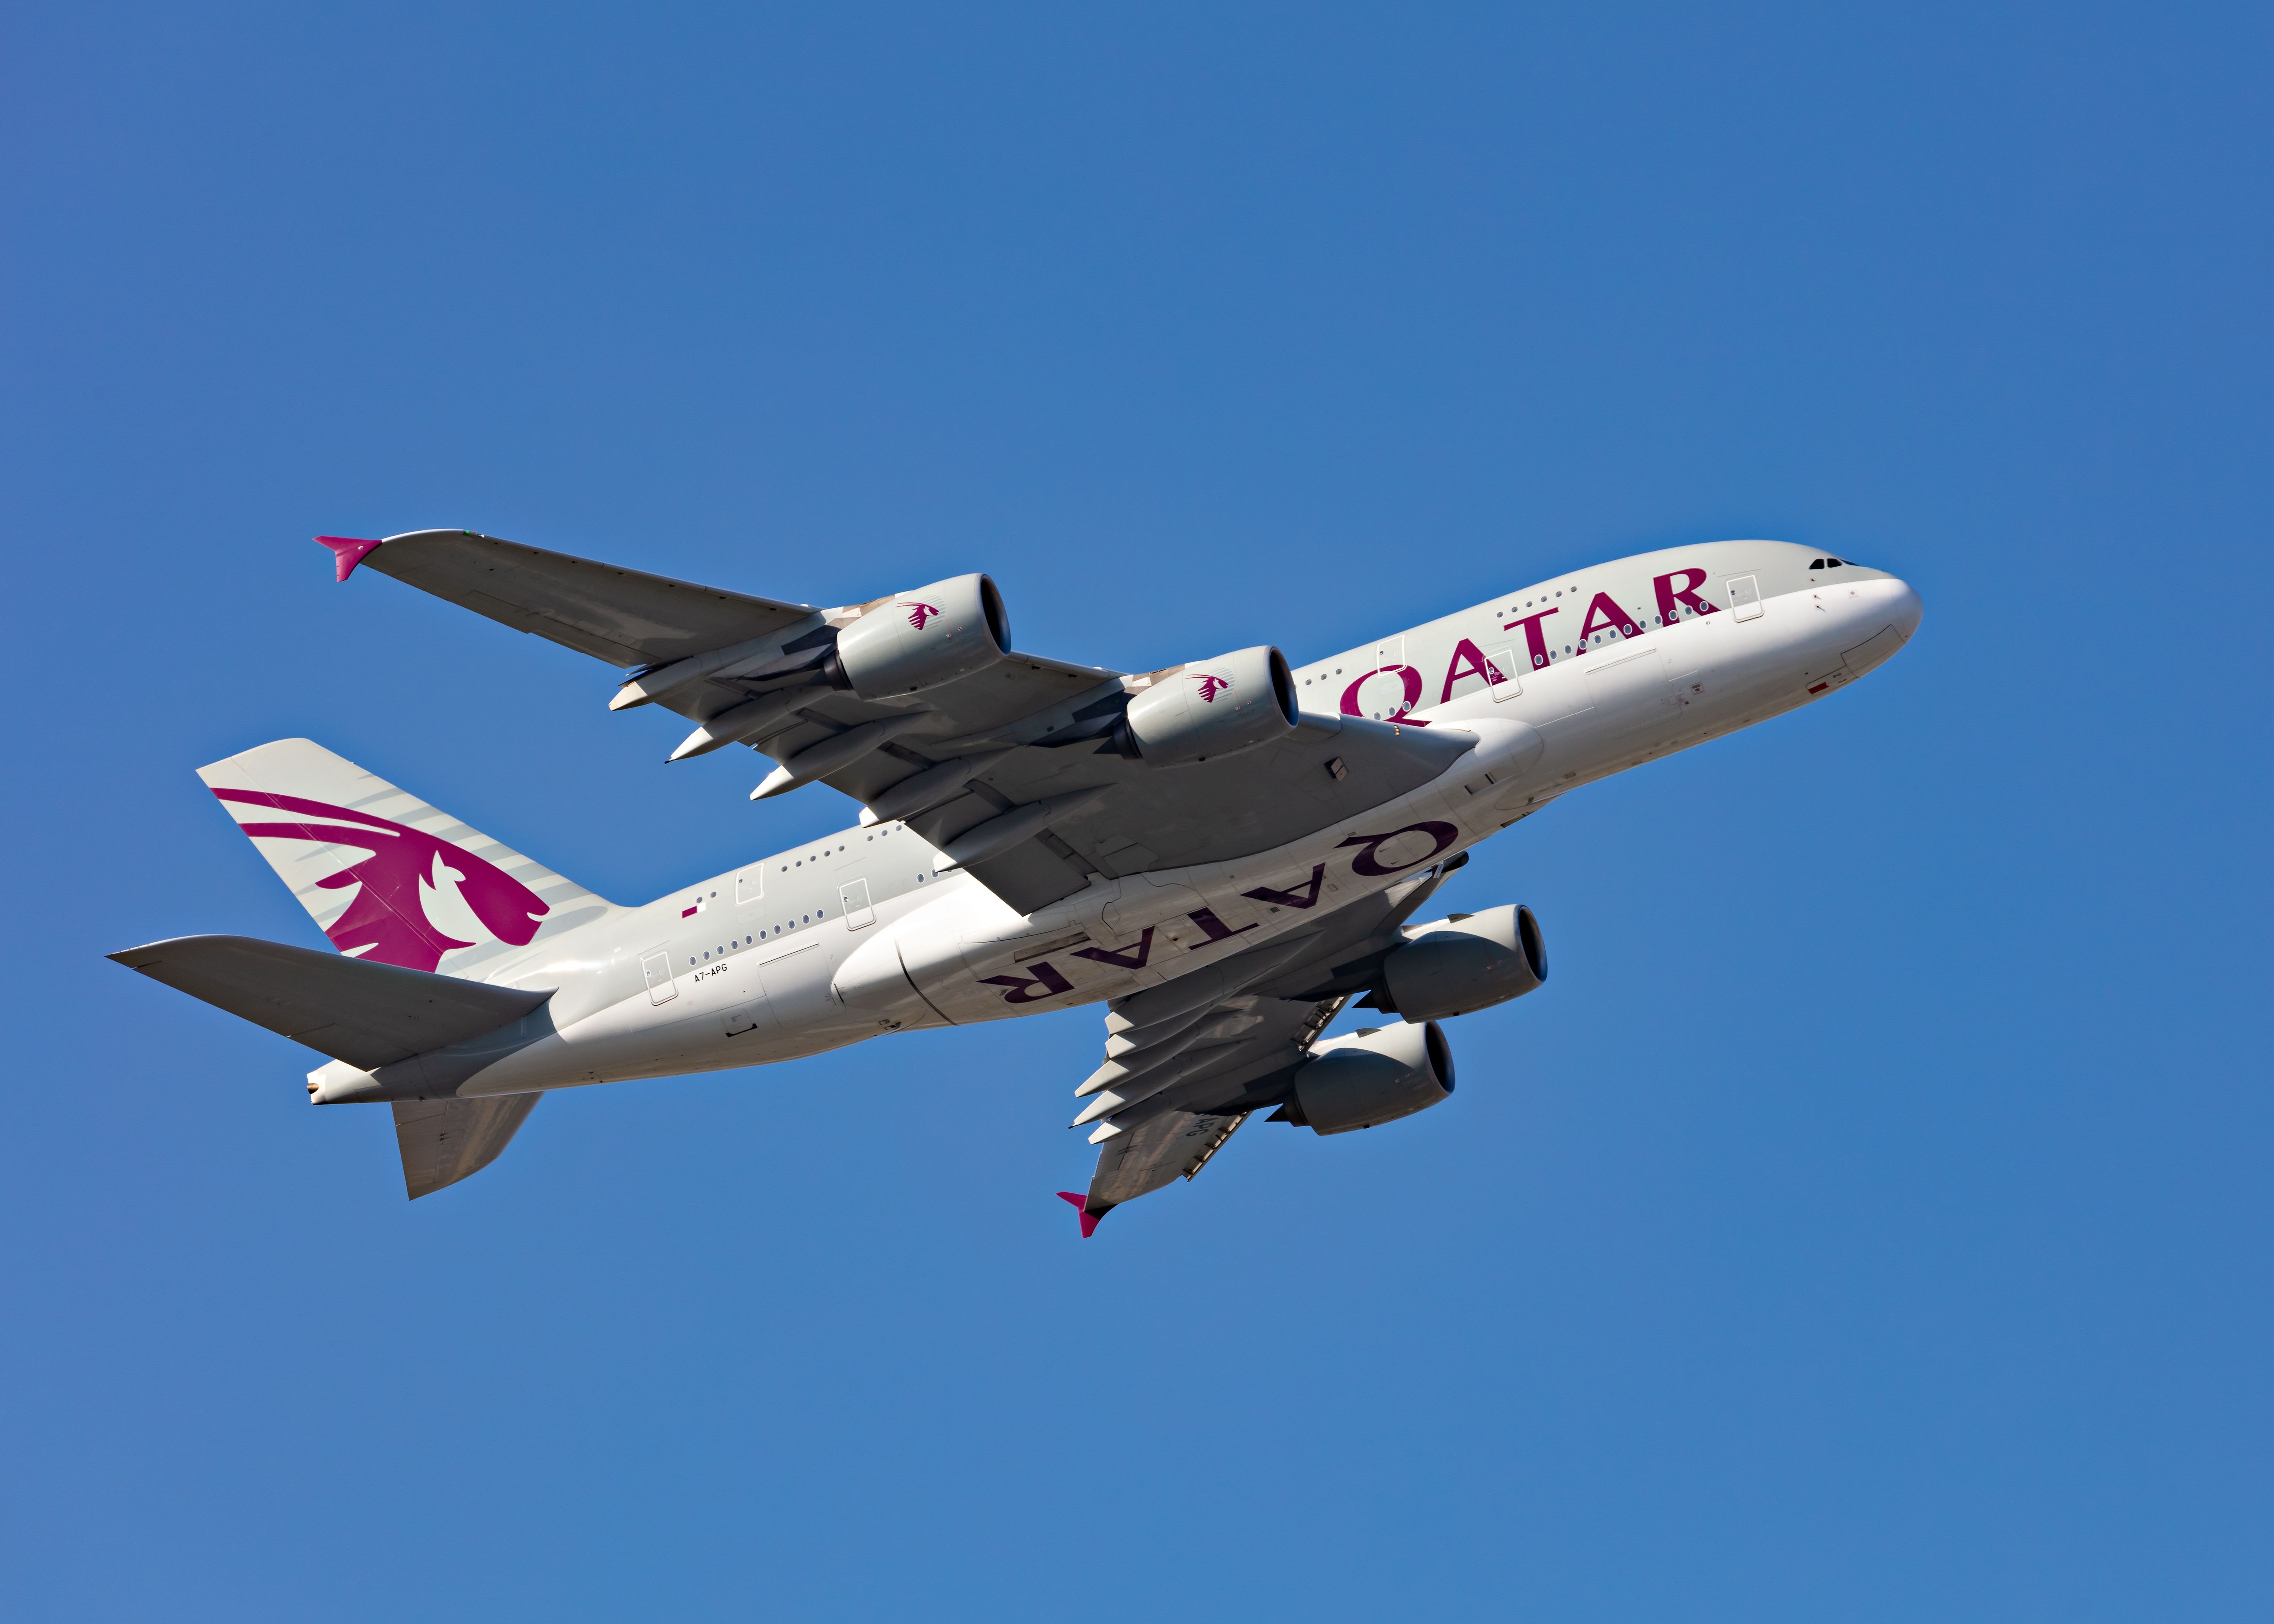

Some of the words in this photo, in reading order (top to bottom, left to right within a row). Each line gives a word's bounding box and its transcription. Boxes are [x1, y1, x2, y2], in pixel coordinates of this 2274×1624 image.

[1340, 568, 1720, 727] QATAR
[695, 963, 727, 982] A7-APG
[976, 821, 1459, 1004] QATAR
